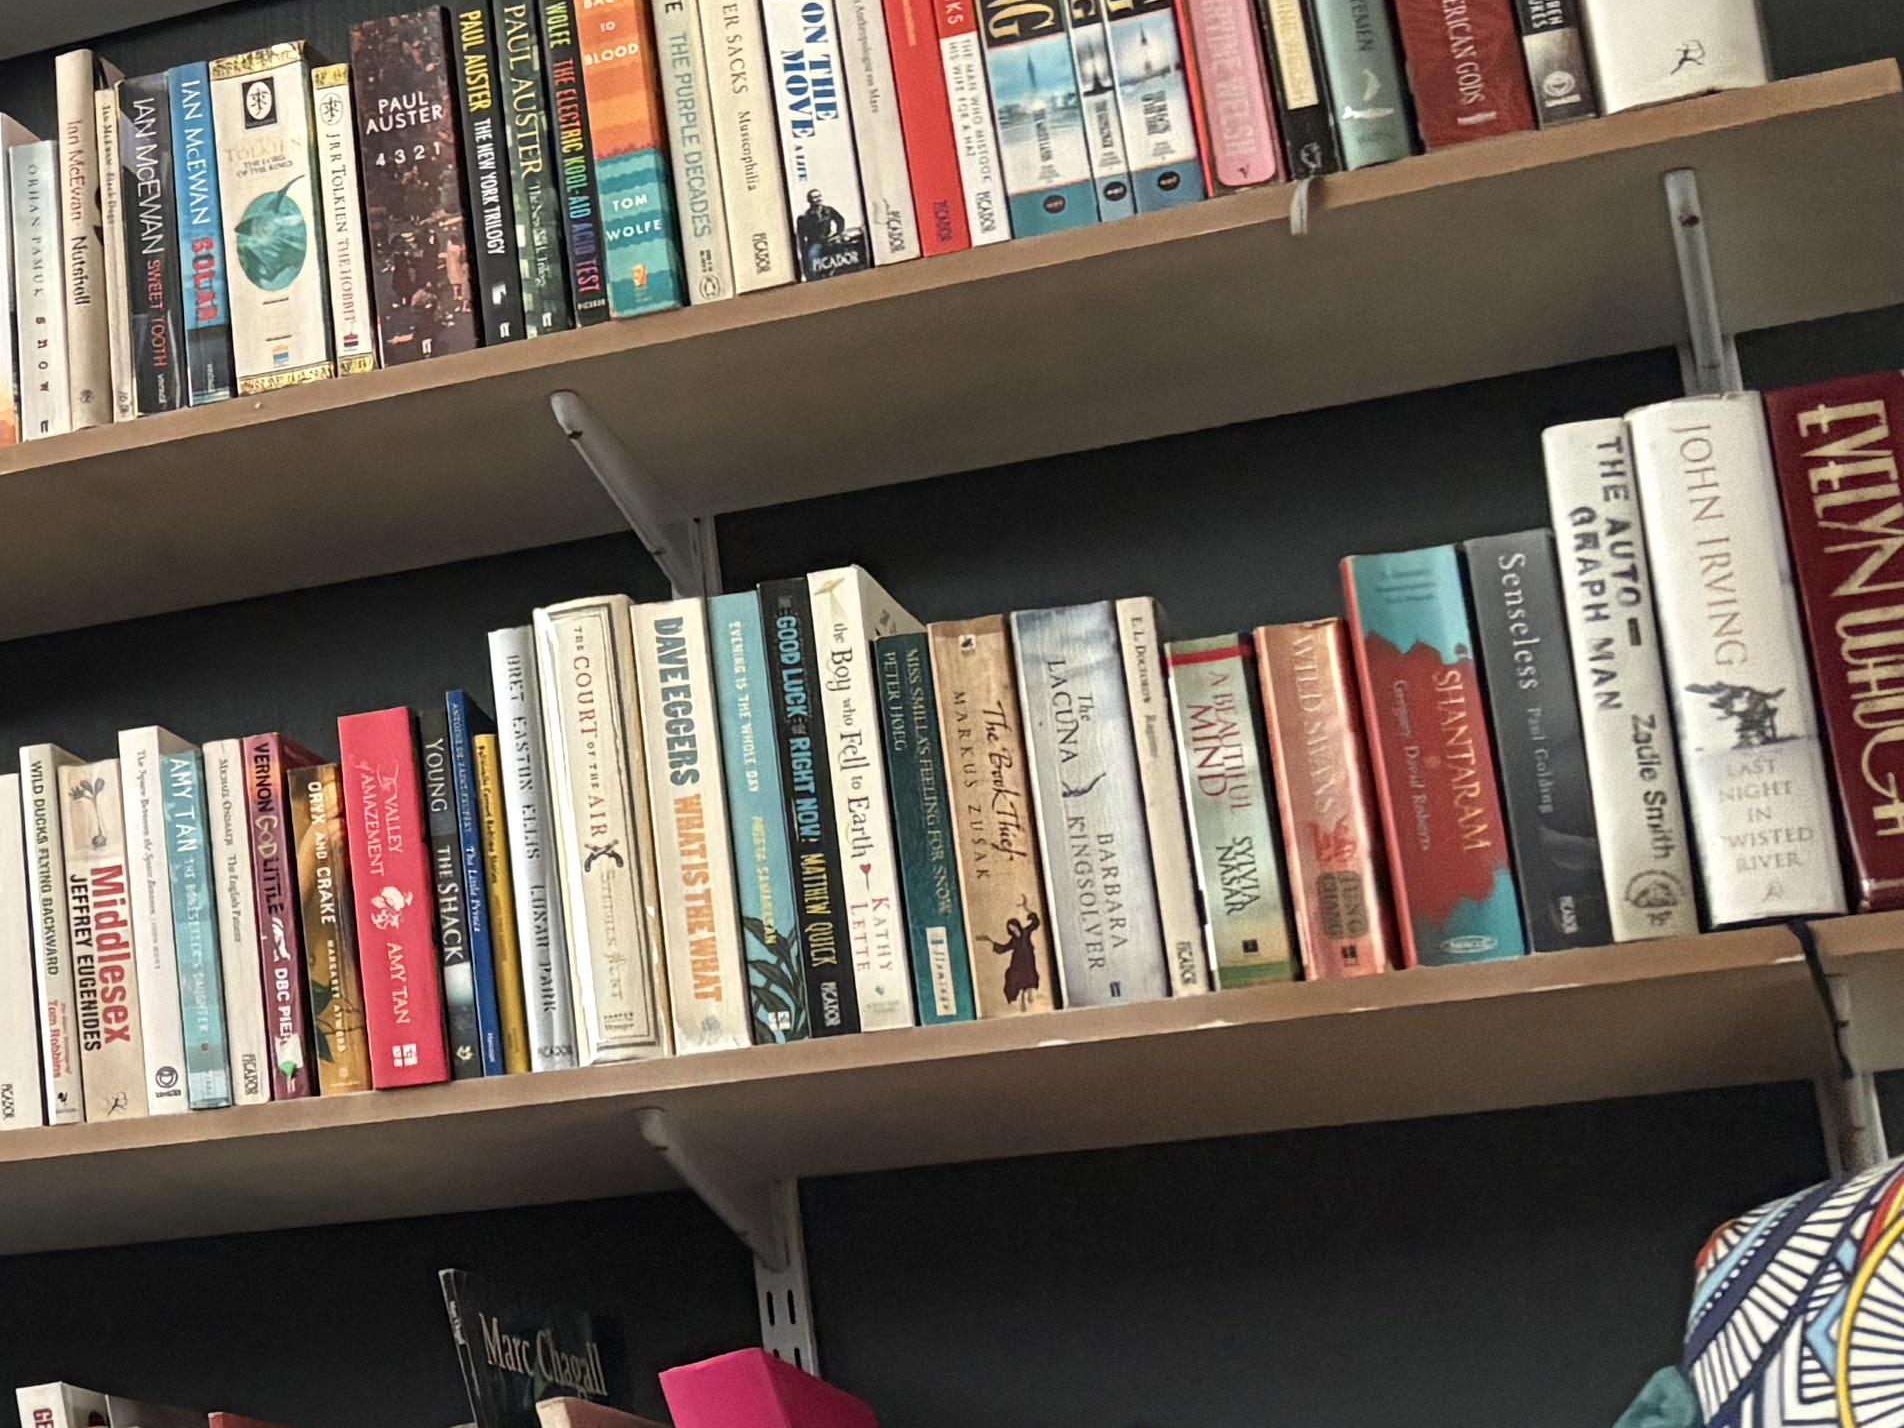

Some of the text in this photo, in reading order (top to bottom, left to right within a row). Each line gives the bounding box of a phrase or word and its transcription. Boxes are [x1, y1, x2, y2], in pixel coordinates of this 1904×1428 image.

[584, 43, 641, 66] BLOOD
[599, 20, 616, 32] TO
[800, 1, 839, 122] ON THE
[365, 102, 444, 135] AUSTER
[377, 91, 429, 113] PAUL
[781, 49, 816, 139] MOVE
[604, 218, 662, 242] WOLFE
[612, 194, 648, 211] TOM
[1668, 423, 1750, 668] JOHN IRVING
[1498, 553, 1539, 691] Senseless
[654, 615, 701, 787] DAVE EGGERS
[1046, 658, 1079, 766] LACUNA
[425, 737, 447, 813] YOUNG
[1433, 669, 1490, 852] SHANTARAM
[1630, 713, 1675, 860] Zadie Smith
[69, 875, 102, 1053] JEFFREY EUGENIDES
[90, 864, 131, 1046] Middlesex
[440, 880, 464, 962] SHACK
[478, 1311, 609, 1400] Marc Chagall
